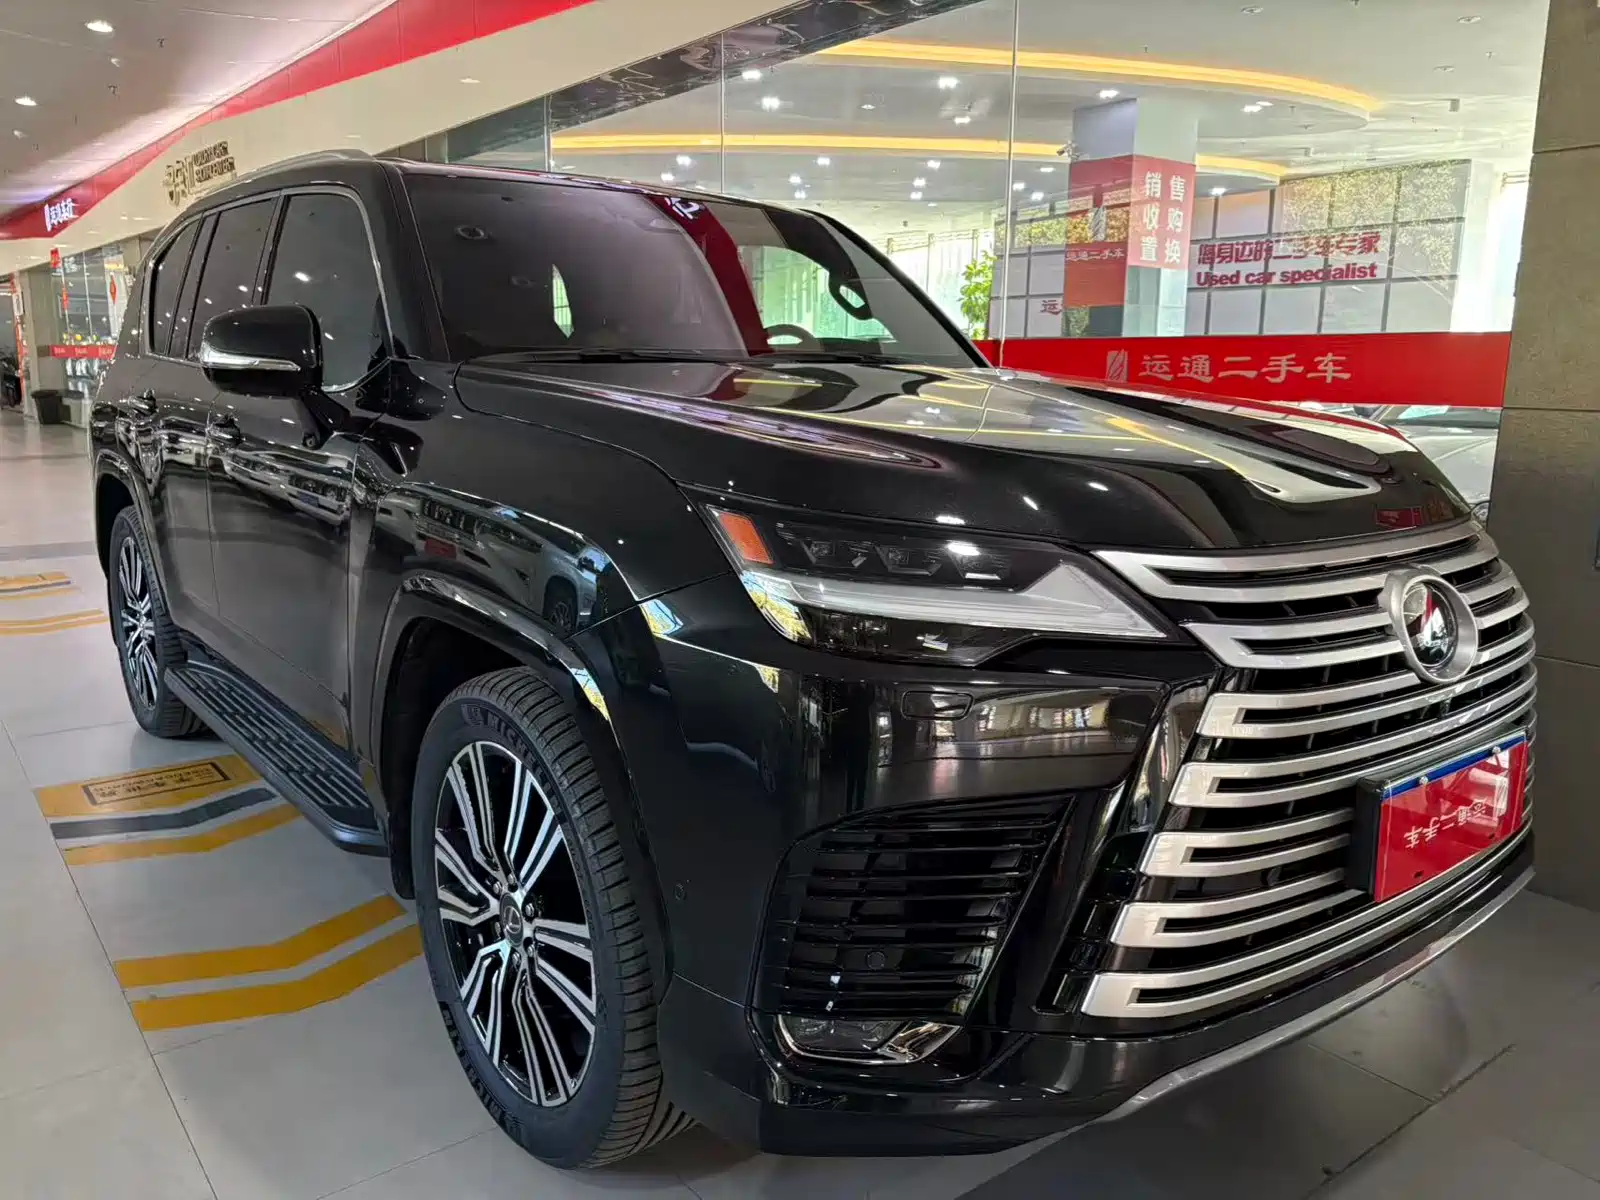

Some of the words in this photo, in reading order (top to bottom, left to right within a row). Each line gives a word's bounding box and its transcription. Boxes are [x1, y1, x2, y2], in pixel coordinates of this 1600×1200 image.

[1196, 269, 1240, 286] Used
[1245, 271, 1276, 284] car
[1280, 261, 1378, 285] specialist
[1138, 352, 1352, 384] 运通二手车
